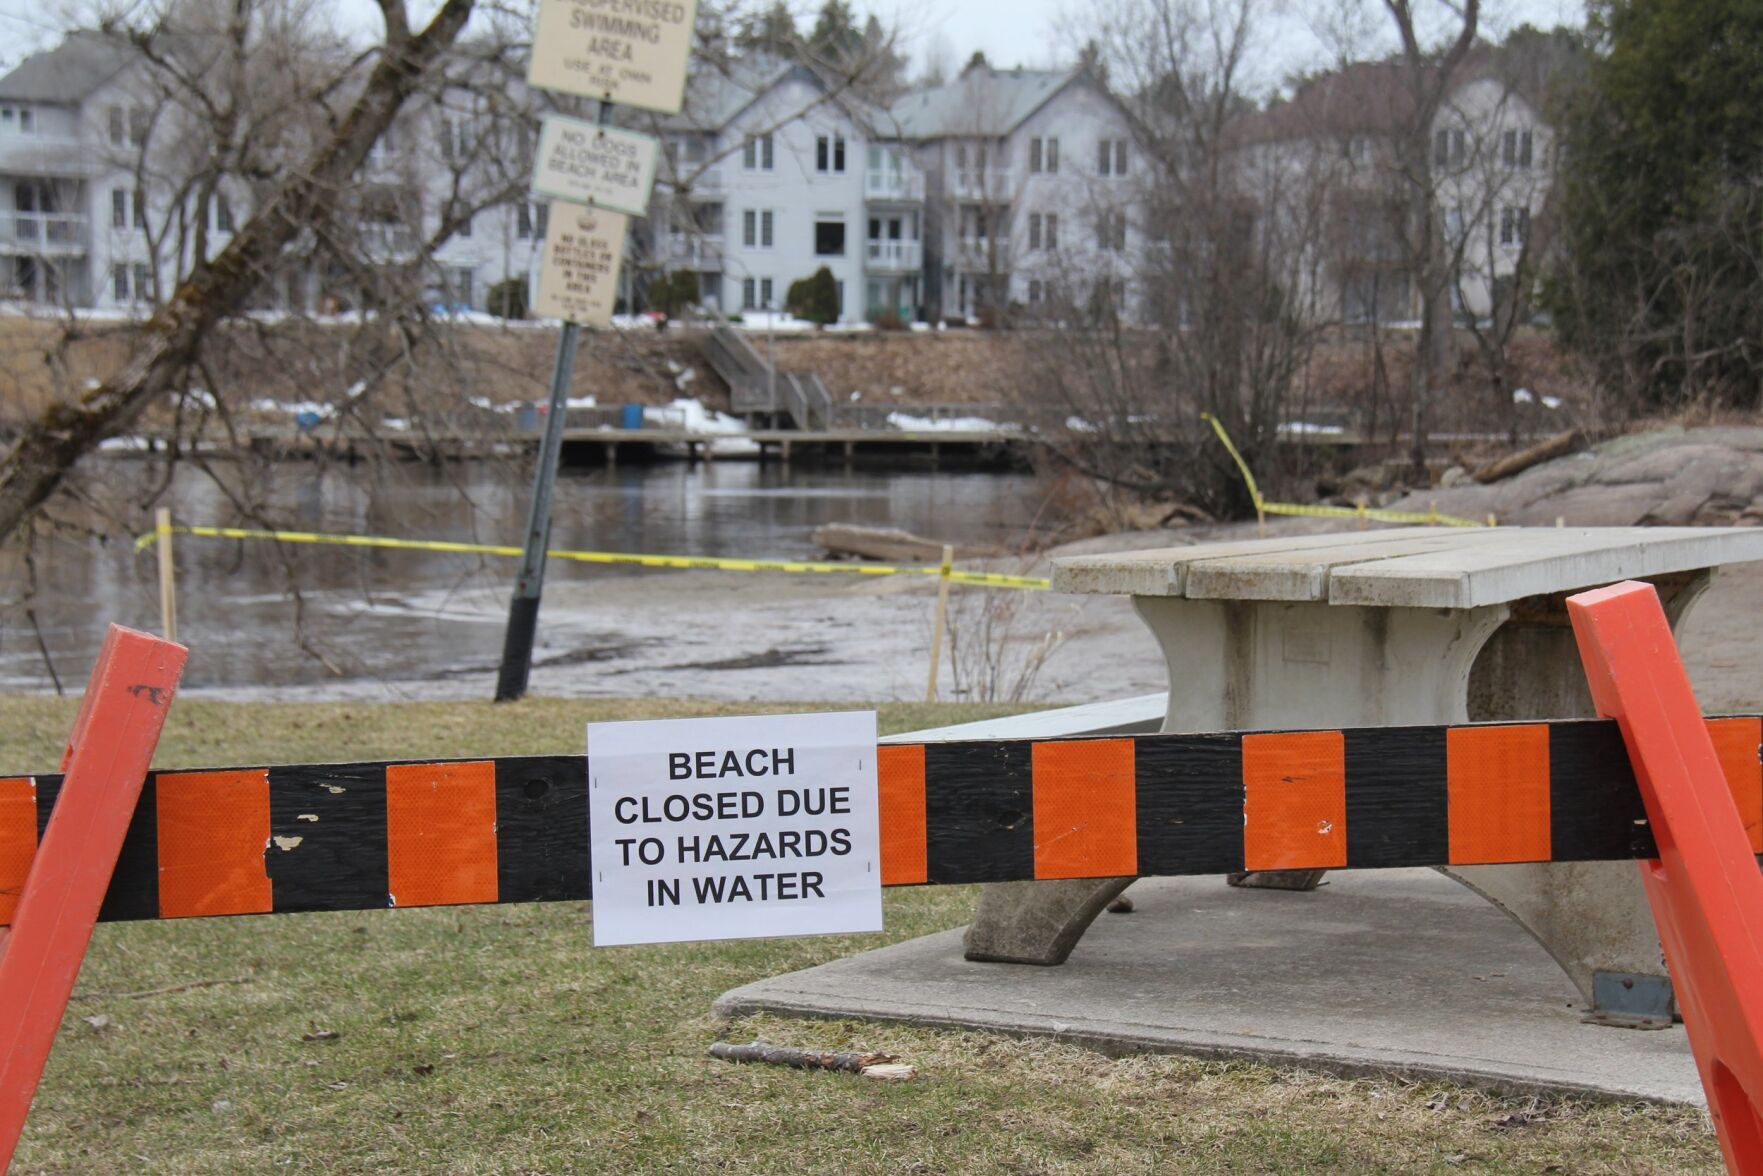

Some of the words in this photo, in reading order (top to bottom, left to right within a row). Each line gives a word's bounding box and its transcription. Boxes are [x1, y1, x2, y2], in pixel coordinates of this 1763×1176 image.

[570, 8, 660, 44] SWIMMING
[588, 37, 633, 61] AREA
[563, 131, 586, 146] NO
[554, 144, 620, 169] ALLOWED
[548, 158, 596, 176] BEACH
[602, 171, 639, 188] AREA
[669, 748, 794, 779] BEACH
[615, 791, 764, 824] CLOSED
[778, 787, 850, 816] DUE
[615, 838, 664, 866] TO
[678, 828, 851, 863] HAZARDS
[648, 879, 680, 906] IN
[693, 871, 825, 903] WATER
